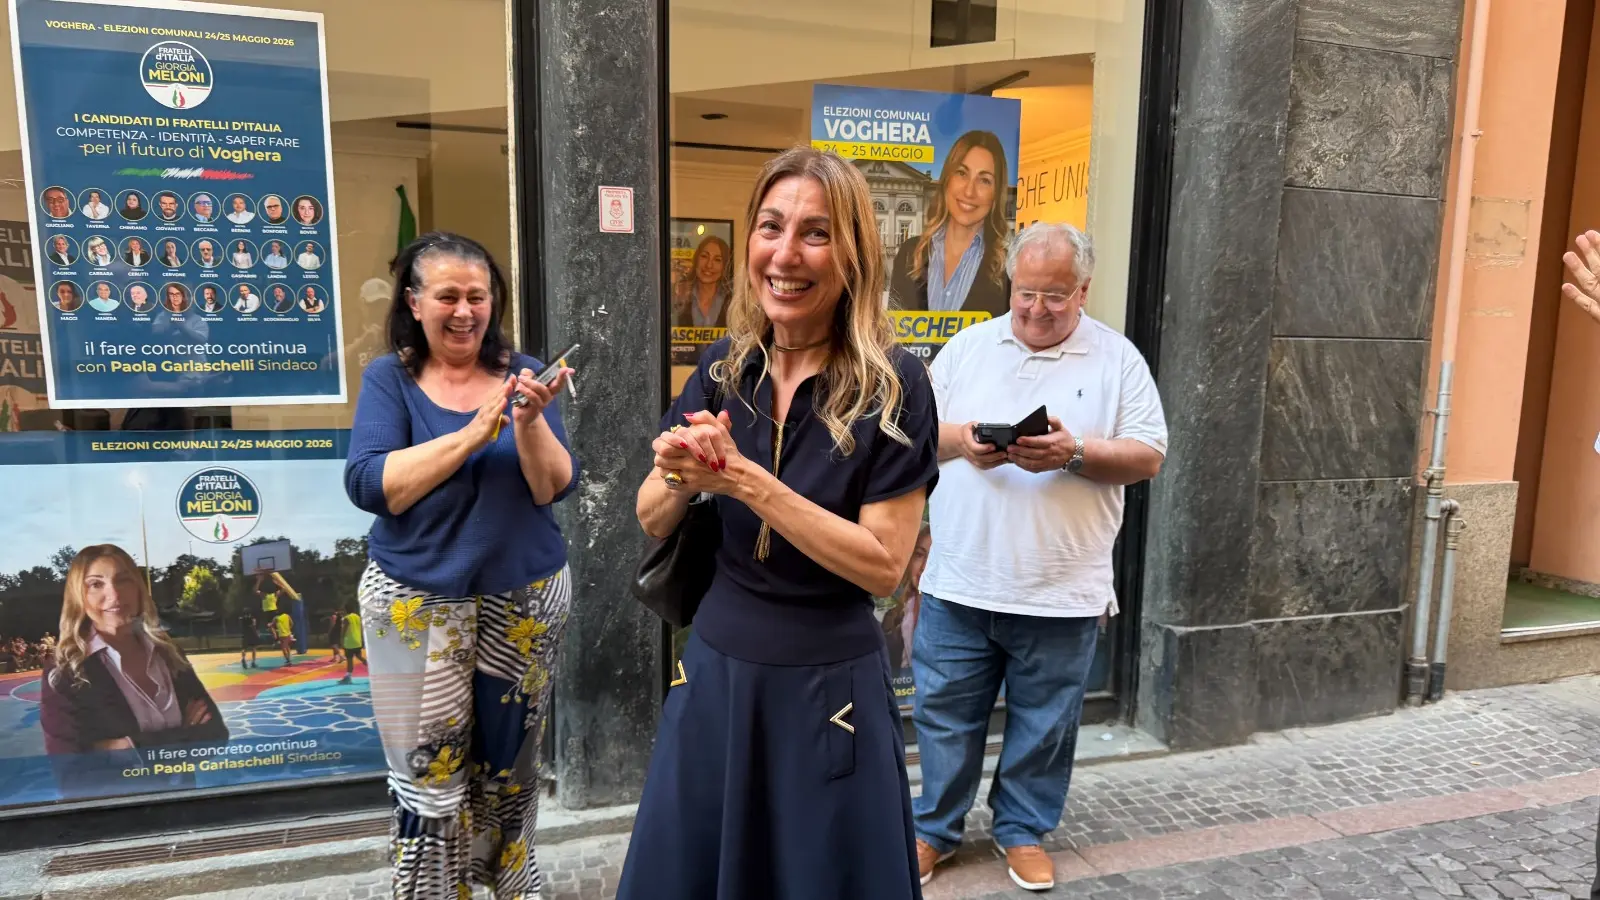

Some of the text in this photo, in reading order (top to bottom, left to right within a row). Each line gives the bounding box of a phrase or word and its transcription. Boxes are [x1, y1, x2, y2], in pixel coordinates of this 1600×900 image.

[45, 19, 96, 31] VOGHERA
[103, 24, 149, 35] ELEZIONI
[151, 28, 203, 39] COMUNALI
[204, 31, 231, 41] 24/25
[232, 34, 271, 46] MAGGIO
[272, 37, 295, 47] 2026
[155, 53, 195, 63] d'ITALIA
[158, 47, 192, 55] FRATELLI
[155, 62, 197, 72] GIORGIA
[148, 68, 205, 83] MELONI
[823, 106, 930, 122] ELEZIONI COMUNALI
[74, 113, 282, 133] I CANDIDATI DI FRATELLI D'ITALIA
[56, 126, 148, 140] COMPETENZA
[158, 130, 215, 144] IDENTITÀ
[225, 136, 266, 147] SAPER
[268, 137, 300, 148] FARE
[823, 118, 932, 144] VOGHERA
[83, 142, 282, 163] per il futuro di Voghera
[851, 145, 866, 156] 25
[870, 147, 923, 160] MAGGIO
[84, 341, 307, 356] il fare concreto continua
[76, 359, 318, 373] con Paola Garlaschelli Sindaco
[91, 440, 333, 451] ELEZIONI COMUNALI 24/25 MAGGIO 2026
[195, 481, 241, 491] d'ITALIA
[194, 491, 243, 501] GIORGIA
[186, 500, 252, 514] MELONI
[147, 738, 317, 761] il fare concreto continua
[122, 751, 342, 777] con Paola Garlaschelli Sindaco
